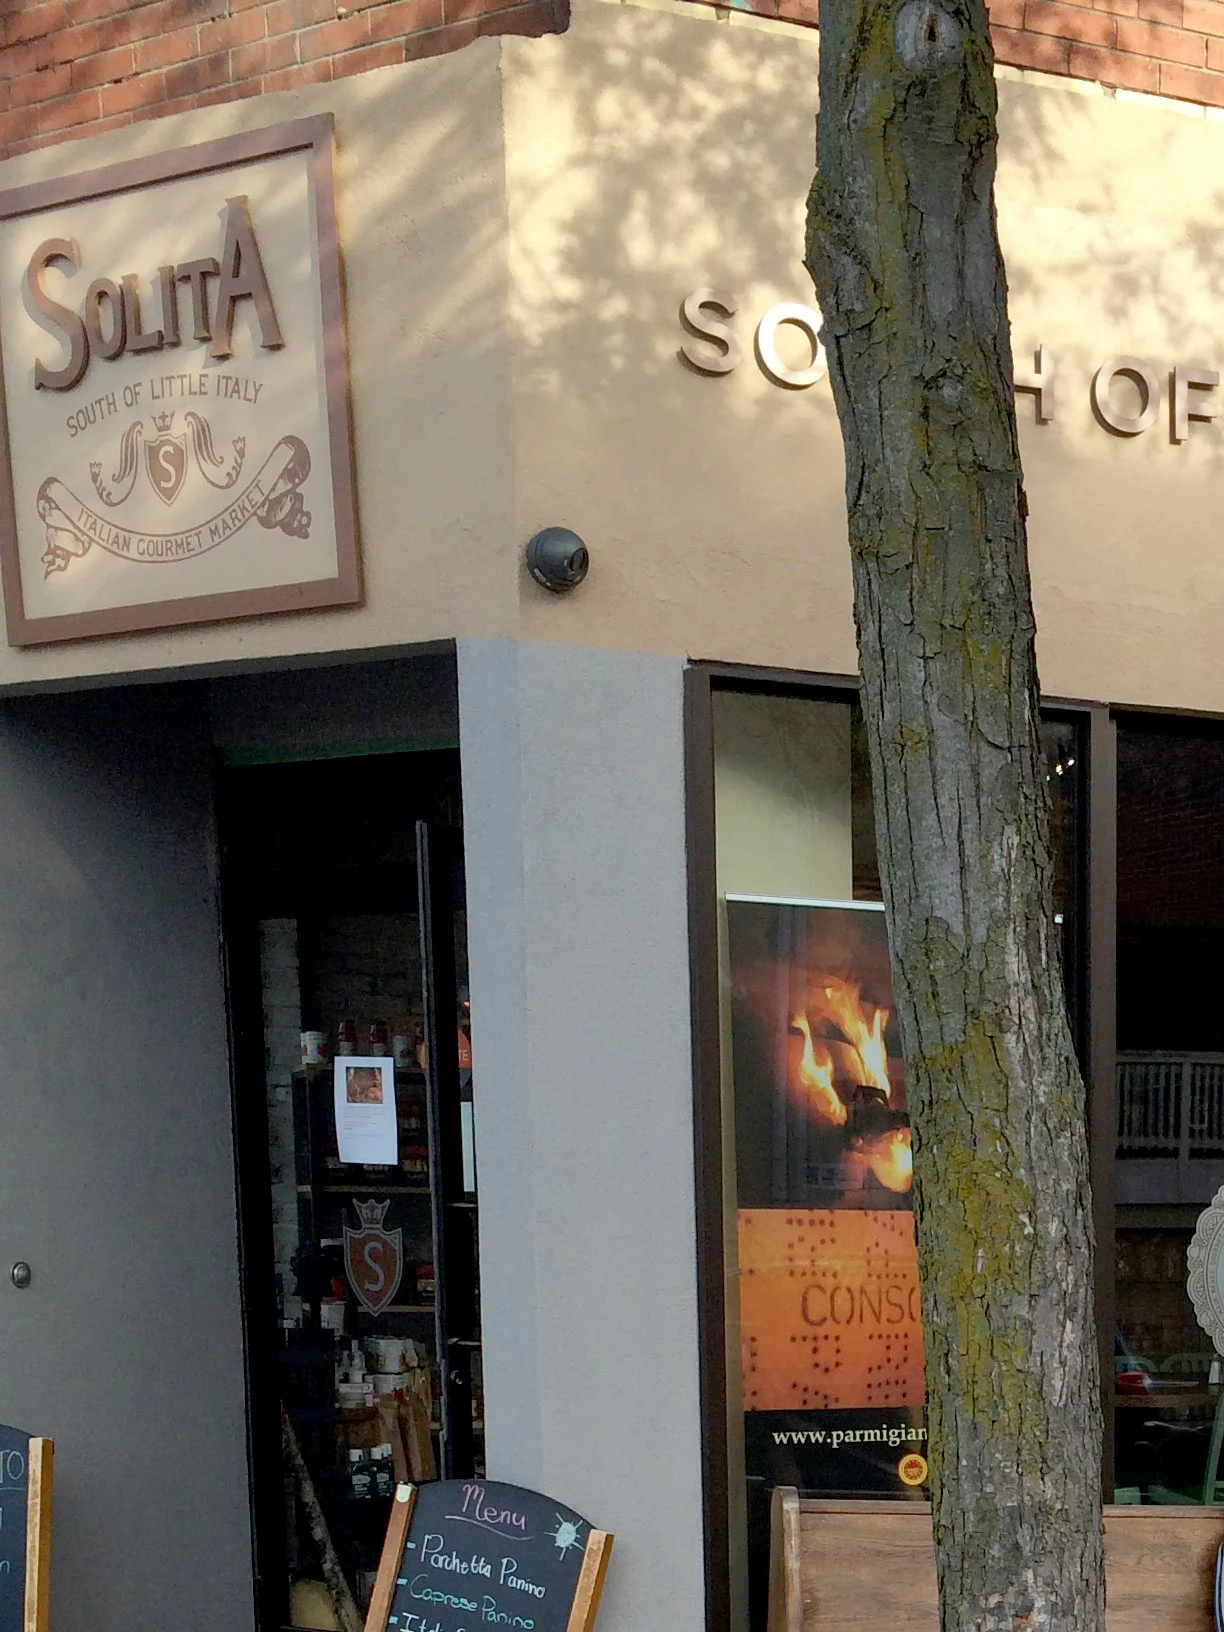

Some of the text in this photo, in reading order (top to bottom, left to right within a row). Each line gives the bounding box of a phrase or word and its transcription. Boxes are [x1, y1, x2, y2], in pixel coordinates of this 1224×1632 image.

[677, 287, 1054, 425] SOH
[1090, 356, 1220, 445] OF
[66, 374, 263, 438] SOUTH OF LITTLE ITALY
[158, 445, 176, 488] S
[77, 480, 265, 556] ITALIAN GOURMET MARKET
[362, 1242, 386, 1292] S
[462, 1484, 526, 1530] Menu
[421, 1534, 546, 1599] Porchetta Panino
[409, 1574, 535, 1630] Caprese Panino
